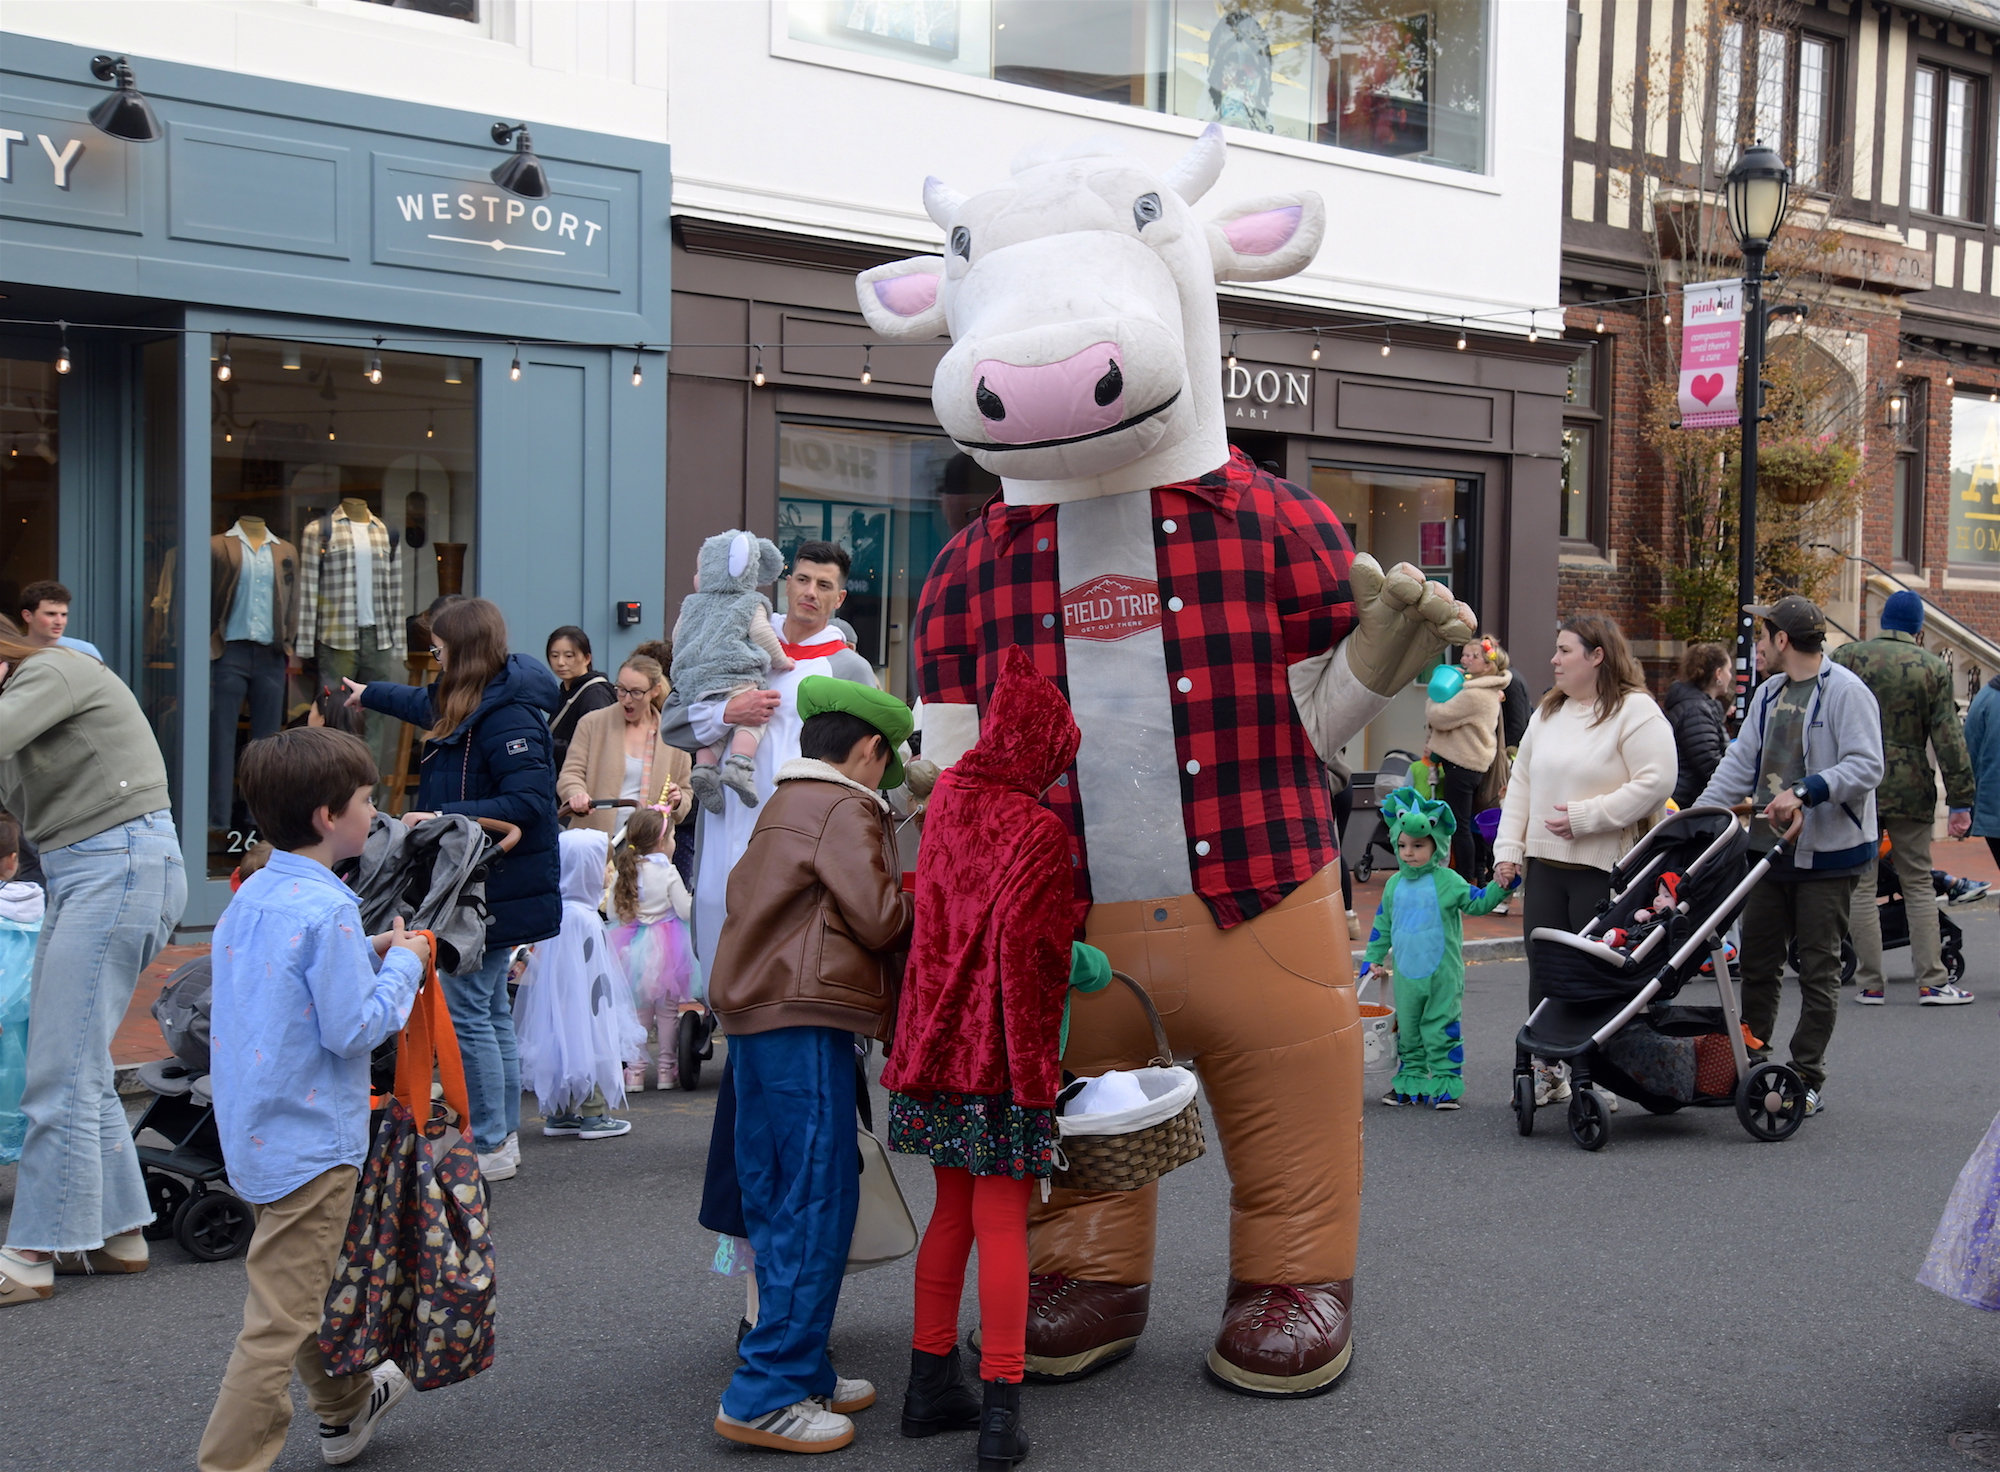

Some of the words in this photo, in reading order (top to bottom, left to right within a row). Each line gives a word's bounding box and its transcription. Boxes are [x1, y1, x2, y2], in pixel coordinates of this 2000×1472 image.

[397, 194, 602, 247] WESTPORT
[1691, 295, 1734, 319] pinkid
[1690, 342, 1707, 353] until
[1708, 340, 1731, 352] there's
[1691, 330, 1732, 344] compassion
[1699, 355, 1706, 363] a
[1706, 353, 1722, 362] cure
[1227, 366, 1310, 406] DON
[1236, 407, 1268, 419] ART
[1064, 598, 1113, 626] FIELD
[1116, 593, 1158, 617] TRIP
